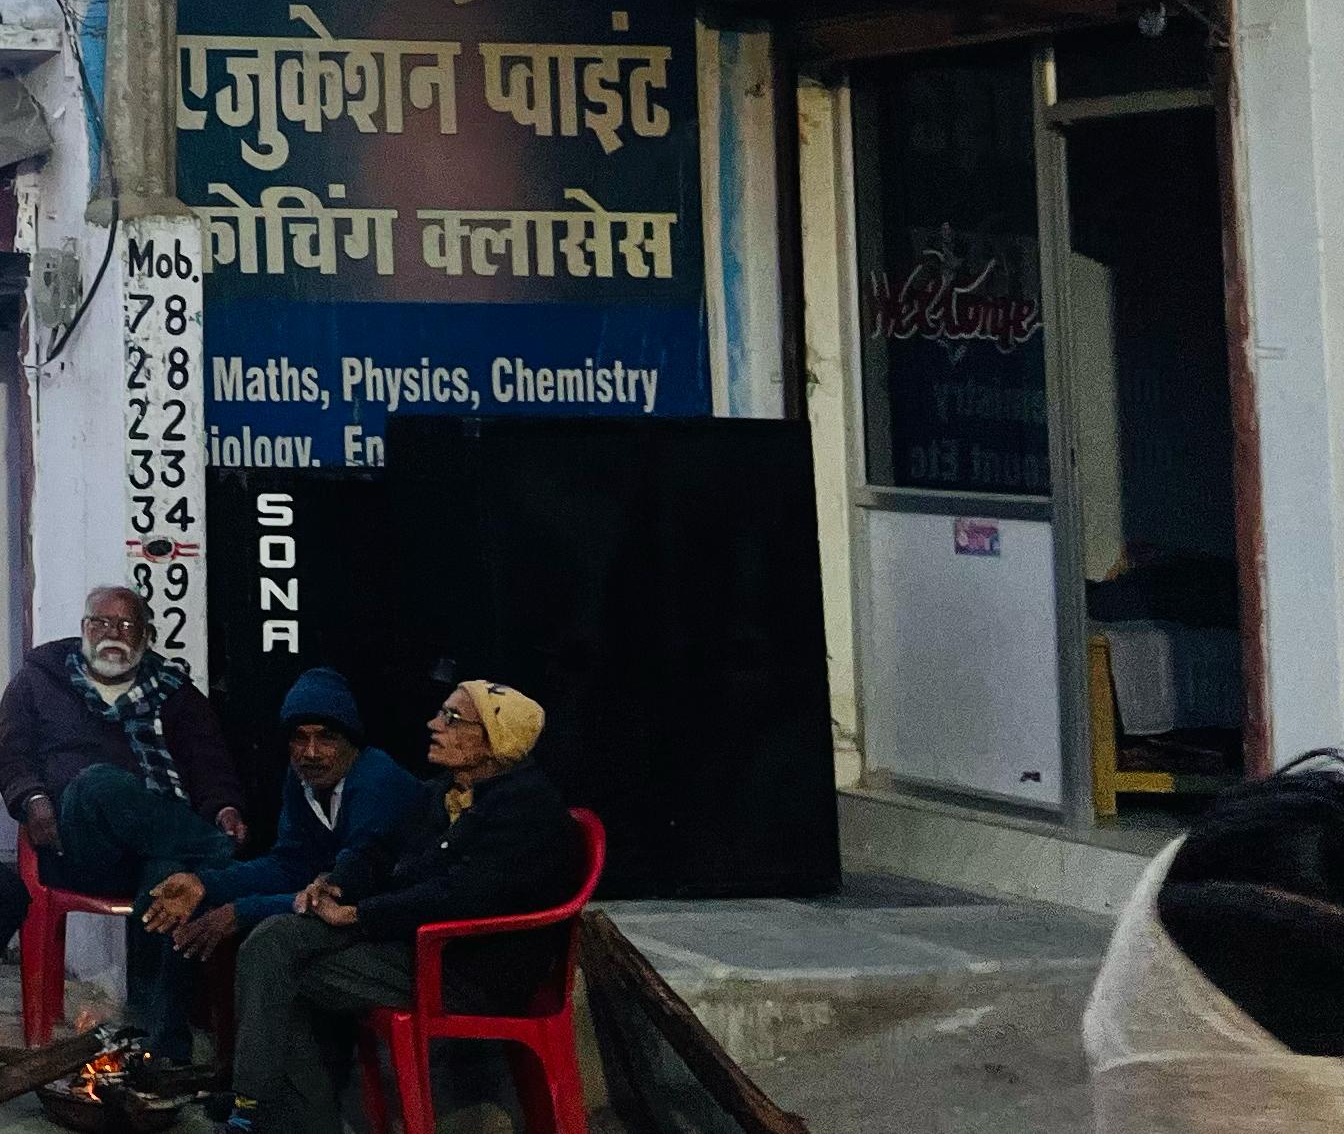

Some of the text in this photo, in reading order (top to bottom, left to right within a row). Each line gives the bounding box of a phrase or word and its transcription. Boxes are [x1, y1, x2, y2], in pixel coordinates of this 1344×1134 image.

[178, 4, 672, 171] एजुकेशन प्वाइंट
[128, 238, 200, 283] Mob.
[416, 188, 679, 279] क्लासेस
[212, 356, 658, 412] Maths, Physics, Chemistry
[202, 425, 322, 467] iology,
